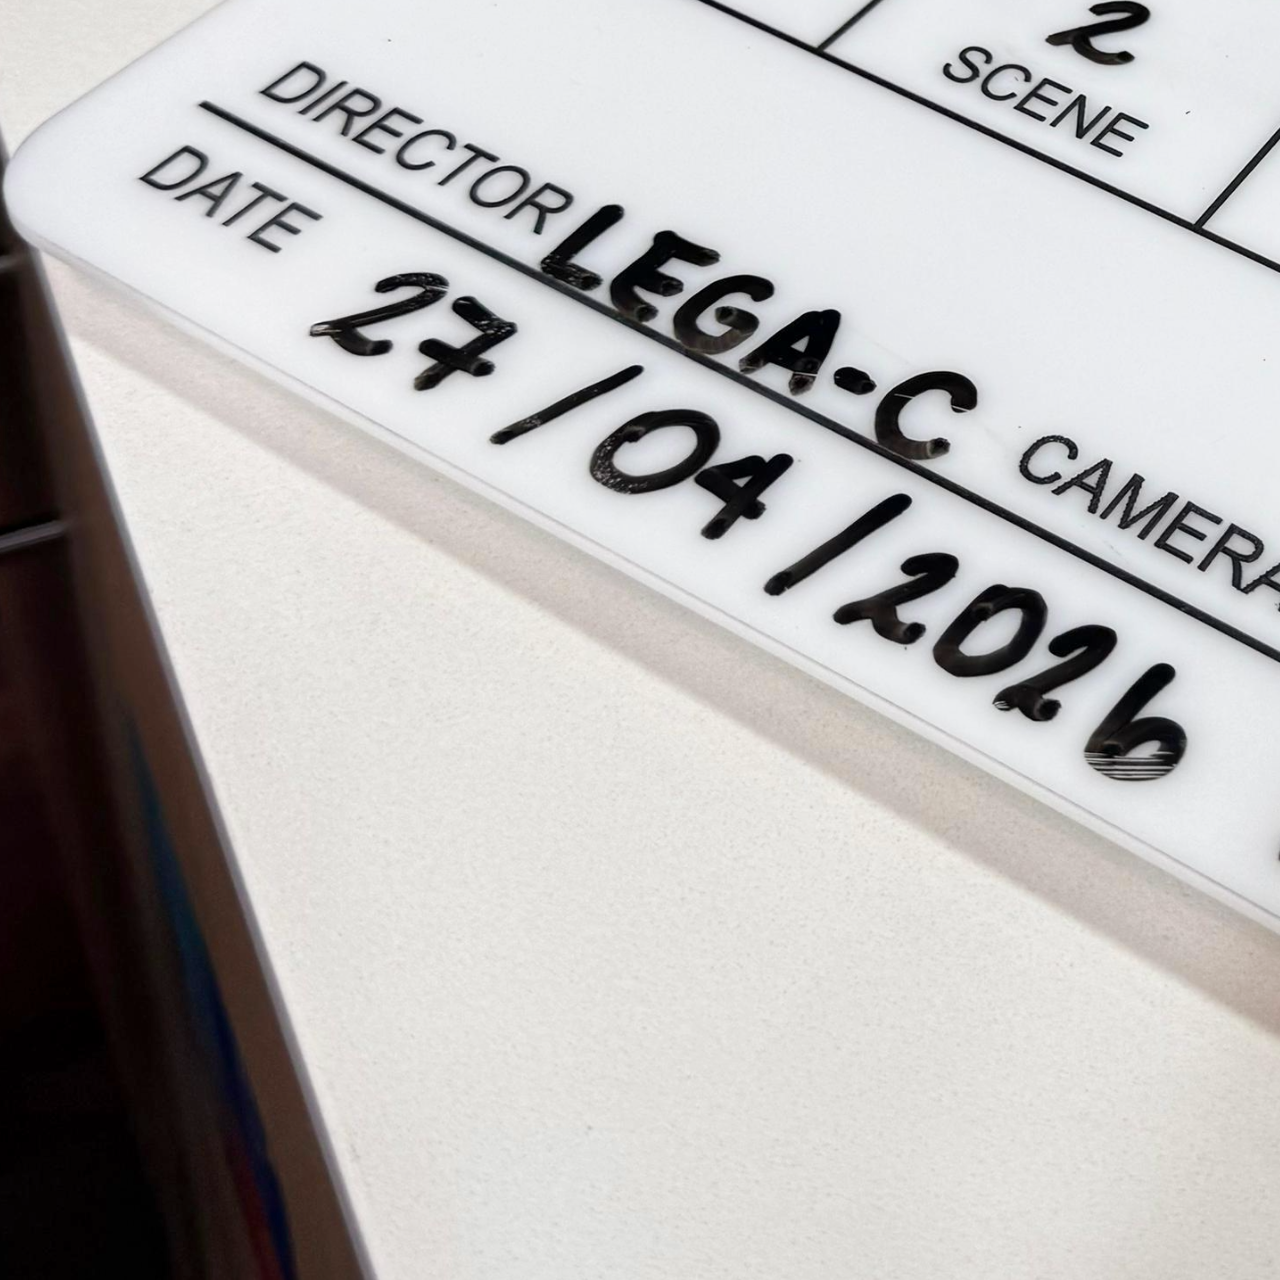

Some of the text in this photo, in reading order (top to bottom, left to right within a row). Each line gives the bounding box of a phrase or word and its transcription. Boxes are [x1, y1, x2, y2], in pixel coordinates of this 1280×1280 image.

[1045, 0, 1151, 65] 2
[260, 61, 575, 234] DIRECTOR
[942, 46, 1149, 158] SCENE
[139, 145, 323, 253] DATE
[540, 204, 978, 461] LEGA-C
